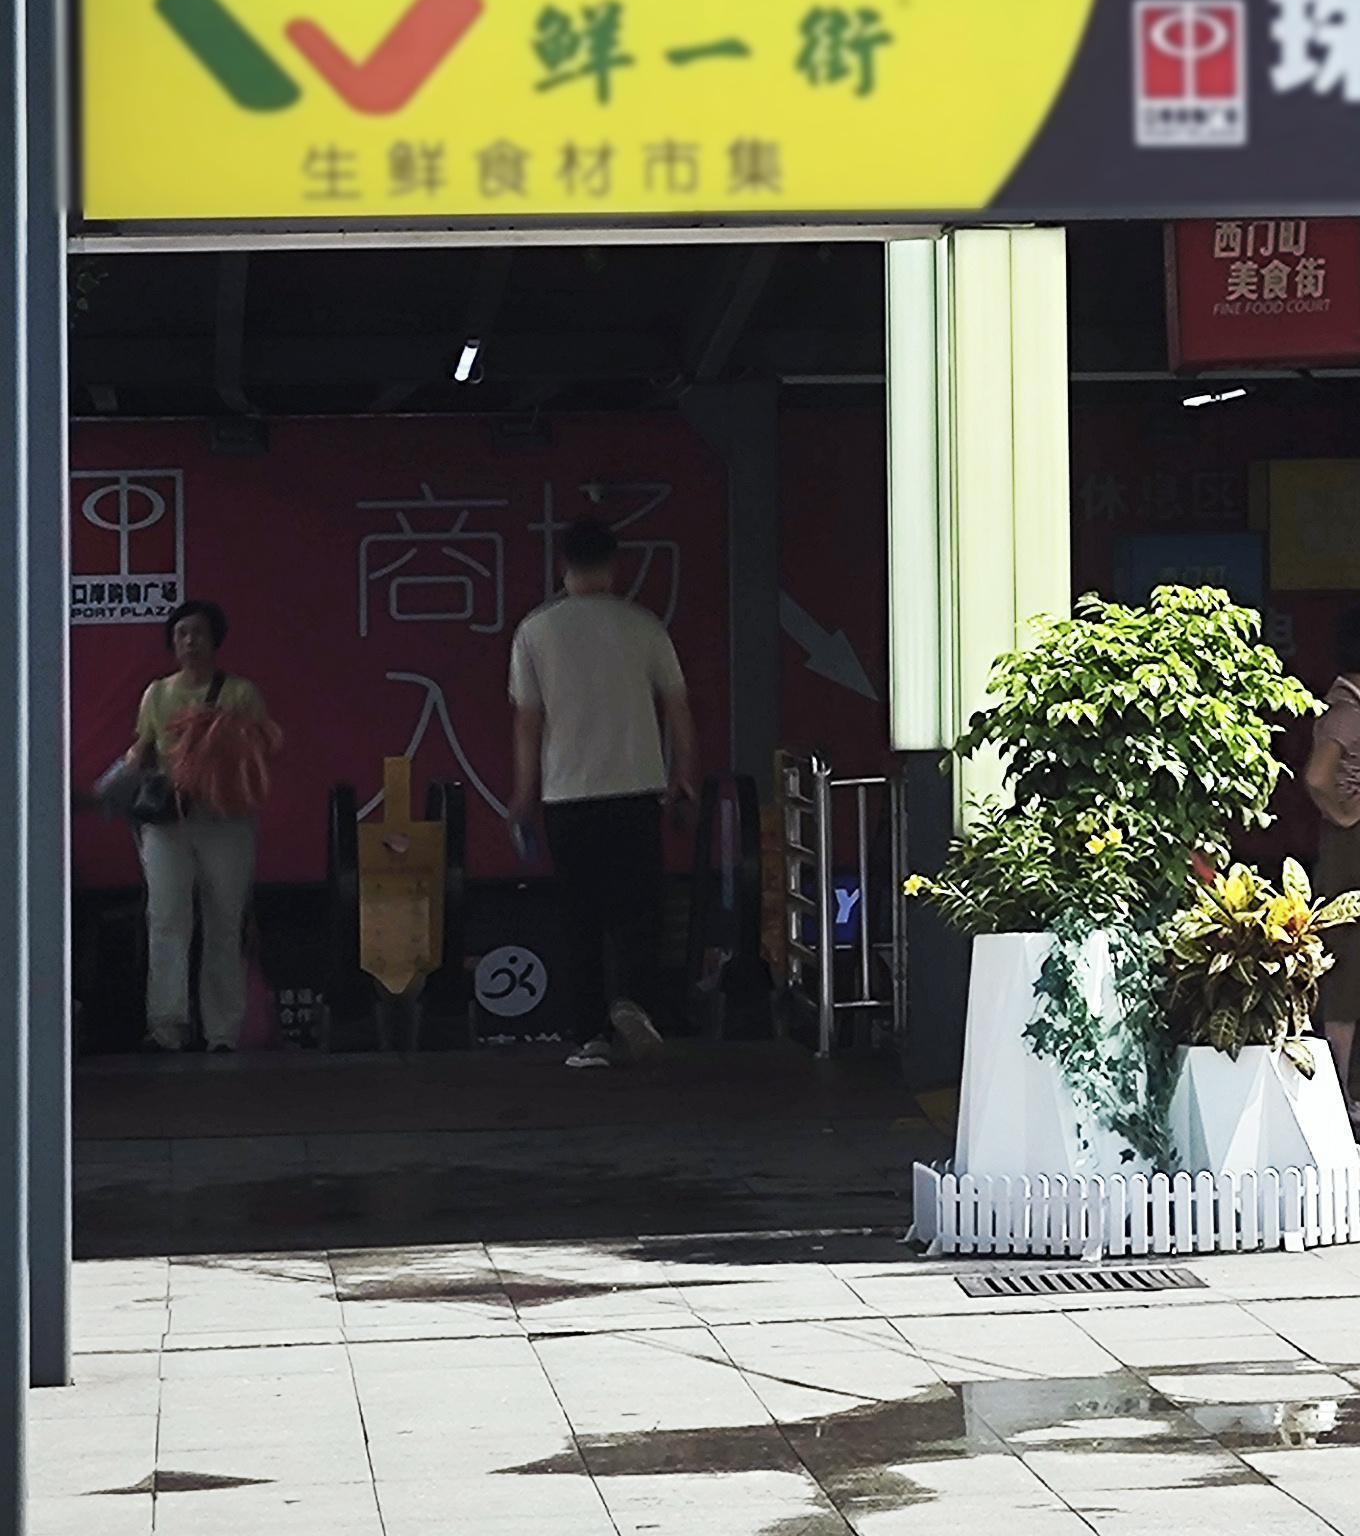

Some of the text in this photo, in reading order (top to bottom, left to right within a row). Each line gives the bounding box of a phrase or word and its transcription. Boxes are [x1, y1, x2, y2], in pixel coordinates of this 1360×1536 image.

[532, 0, 894, 106] 鲜一街
[301, 136, 787, 204] 生鲜食材市集
[1226, 258, 1326, 300] 美食街
[1245, 302, 1284, 314] FOOD
[1286, 299, 1331, 312] COURT
[356, 481, 682, 637] 商场
